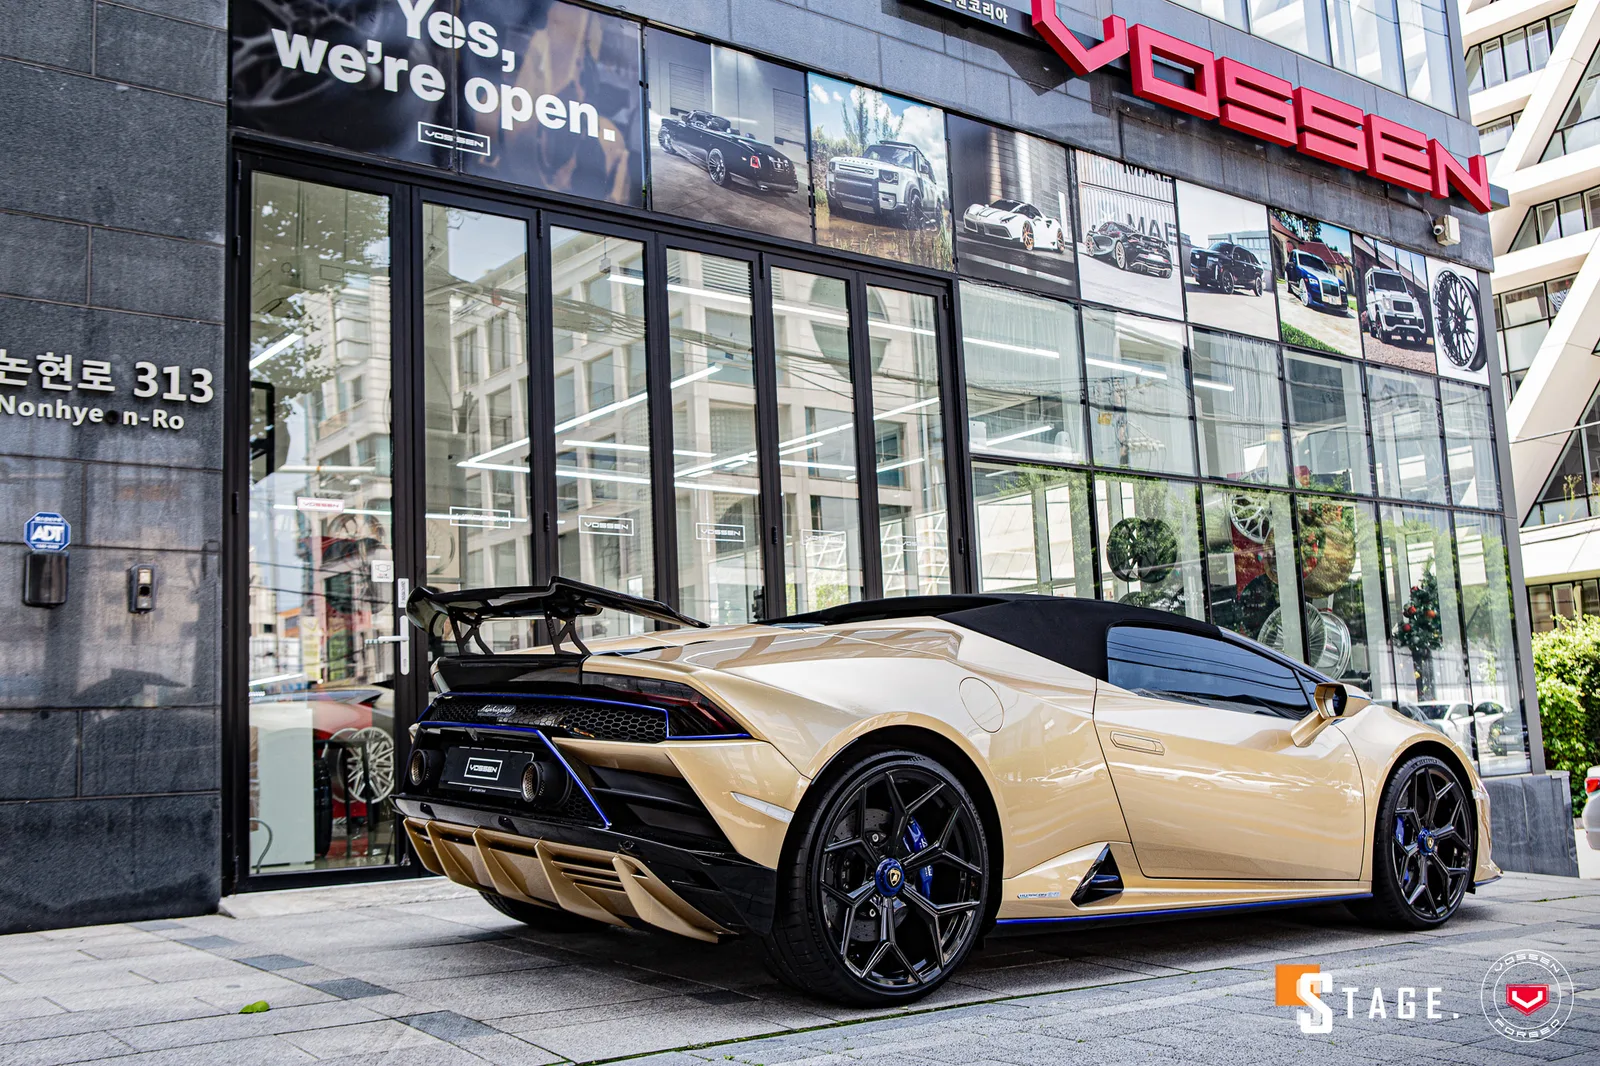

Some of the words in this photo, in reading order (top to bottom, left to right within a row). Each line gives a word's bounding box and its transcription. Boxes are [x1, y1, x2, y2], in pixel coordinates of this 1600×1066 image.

[398, 0, 516, 73] Yes,
[271, 28, 446, 102] we're
[464, 76, 616, 142] open.
[1032, 0, 1492, 213] VOSSEN
[425, 130, 484, 148] VOSSEN
[0, 349, 116, 391] 논현로
[133, 361, 214, 404] 313
[31, 525, 65, 542] ADT
[584, 521, 629, 530] VOSSEN
[700, 528, 741, 537] VOSSEN
[469, 763, 498, 773] VOSSEN
